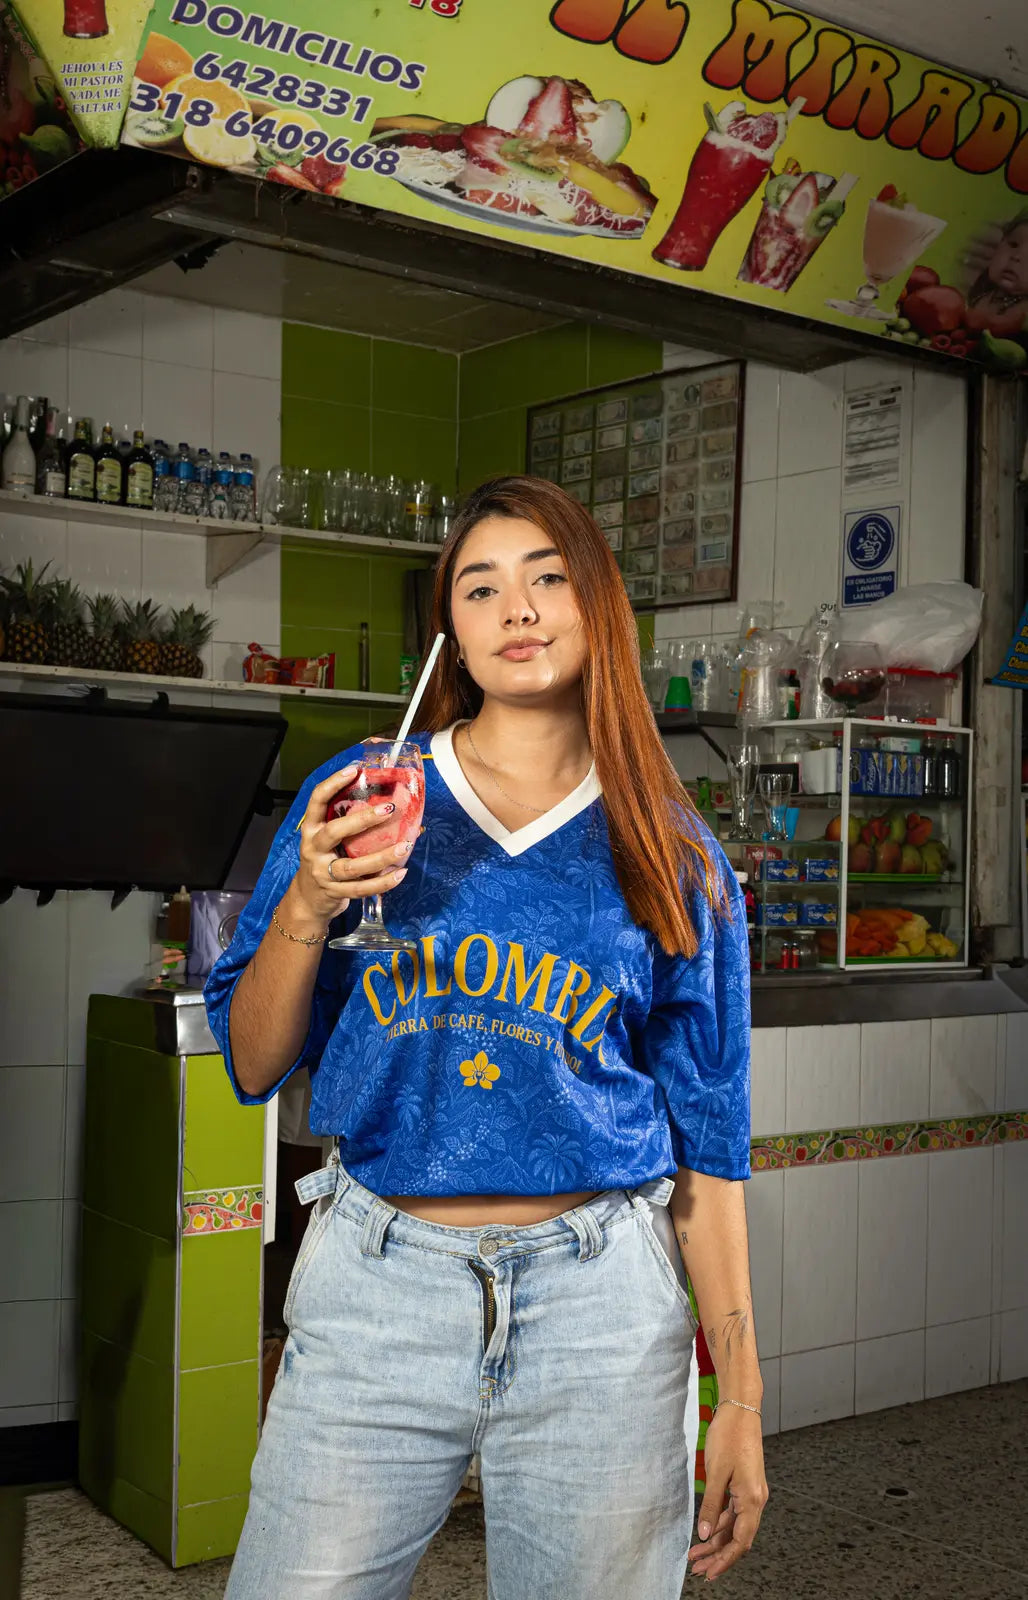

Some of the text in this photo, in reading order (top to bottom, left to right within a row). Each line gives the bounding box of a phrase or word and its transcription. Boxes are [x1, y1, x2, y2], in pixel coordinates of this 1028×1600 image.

[170, 0, 426, 90] DOMICILIOS
[60, 60, 123, 74] JEHOVA ES
[64, 74, 124, 87] MI PASTOR
[193, 52, 373, 124] 6428331
[70, 88, 121, 100] NADA ME
[73, 101, 122, 113] FALTARA
[129, 83, 400, 177] 318 6409668
[433, 1014, 446, 1029] DE
[491, 1019, 542, 1046] FLORES
[545, 1036, 554, 1051] Y
